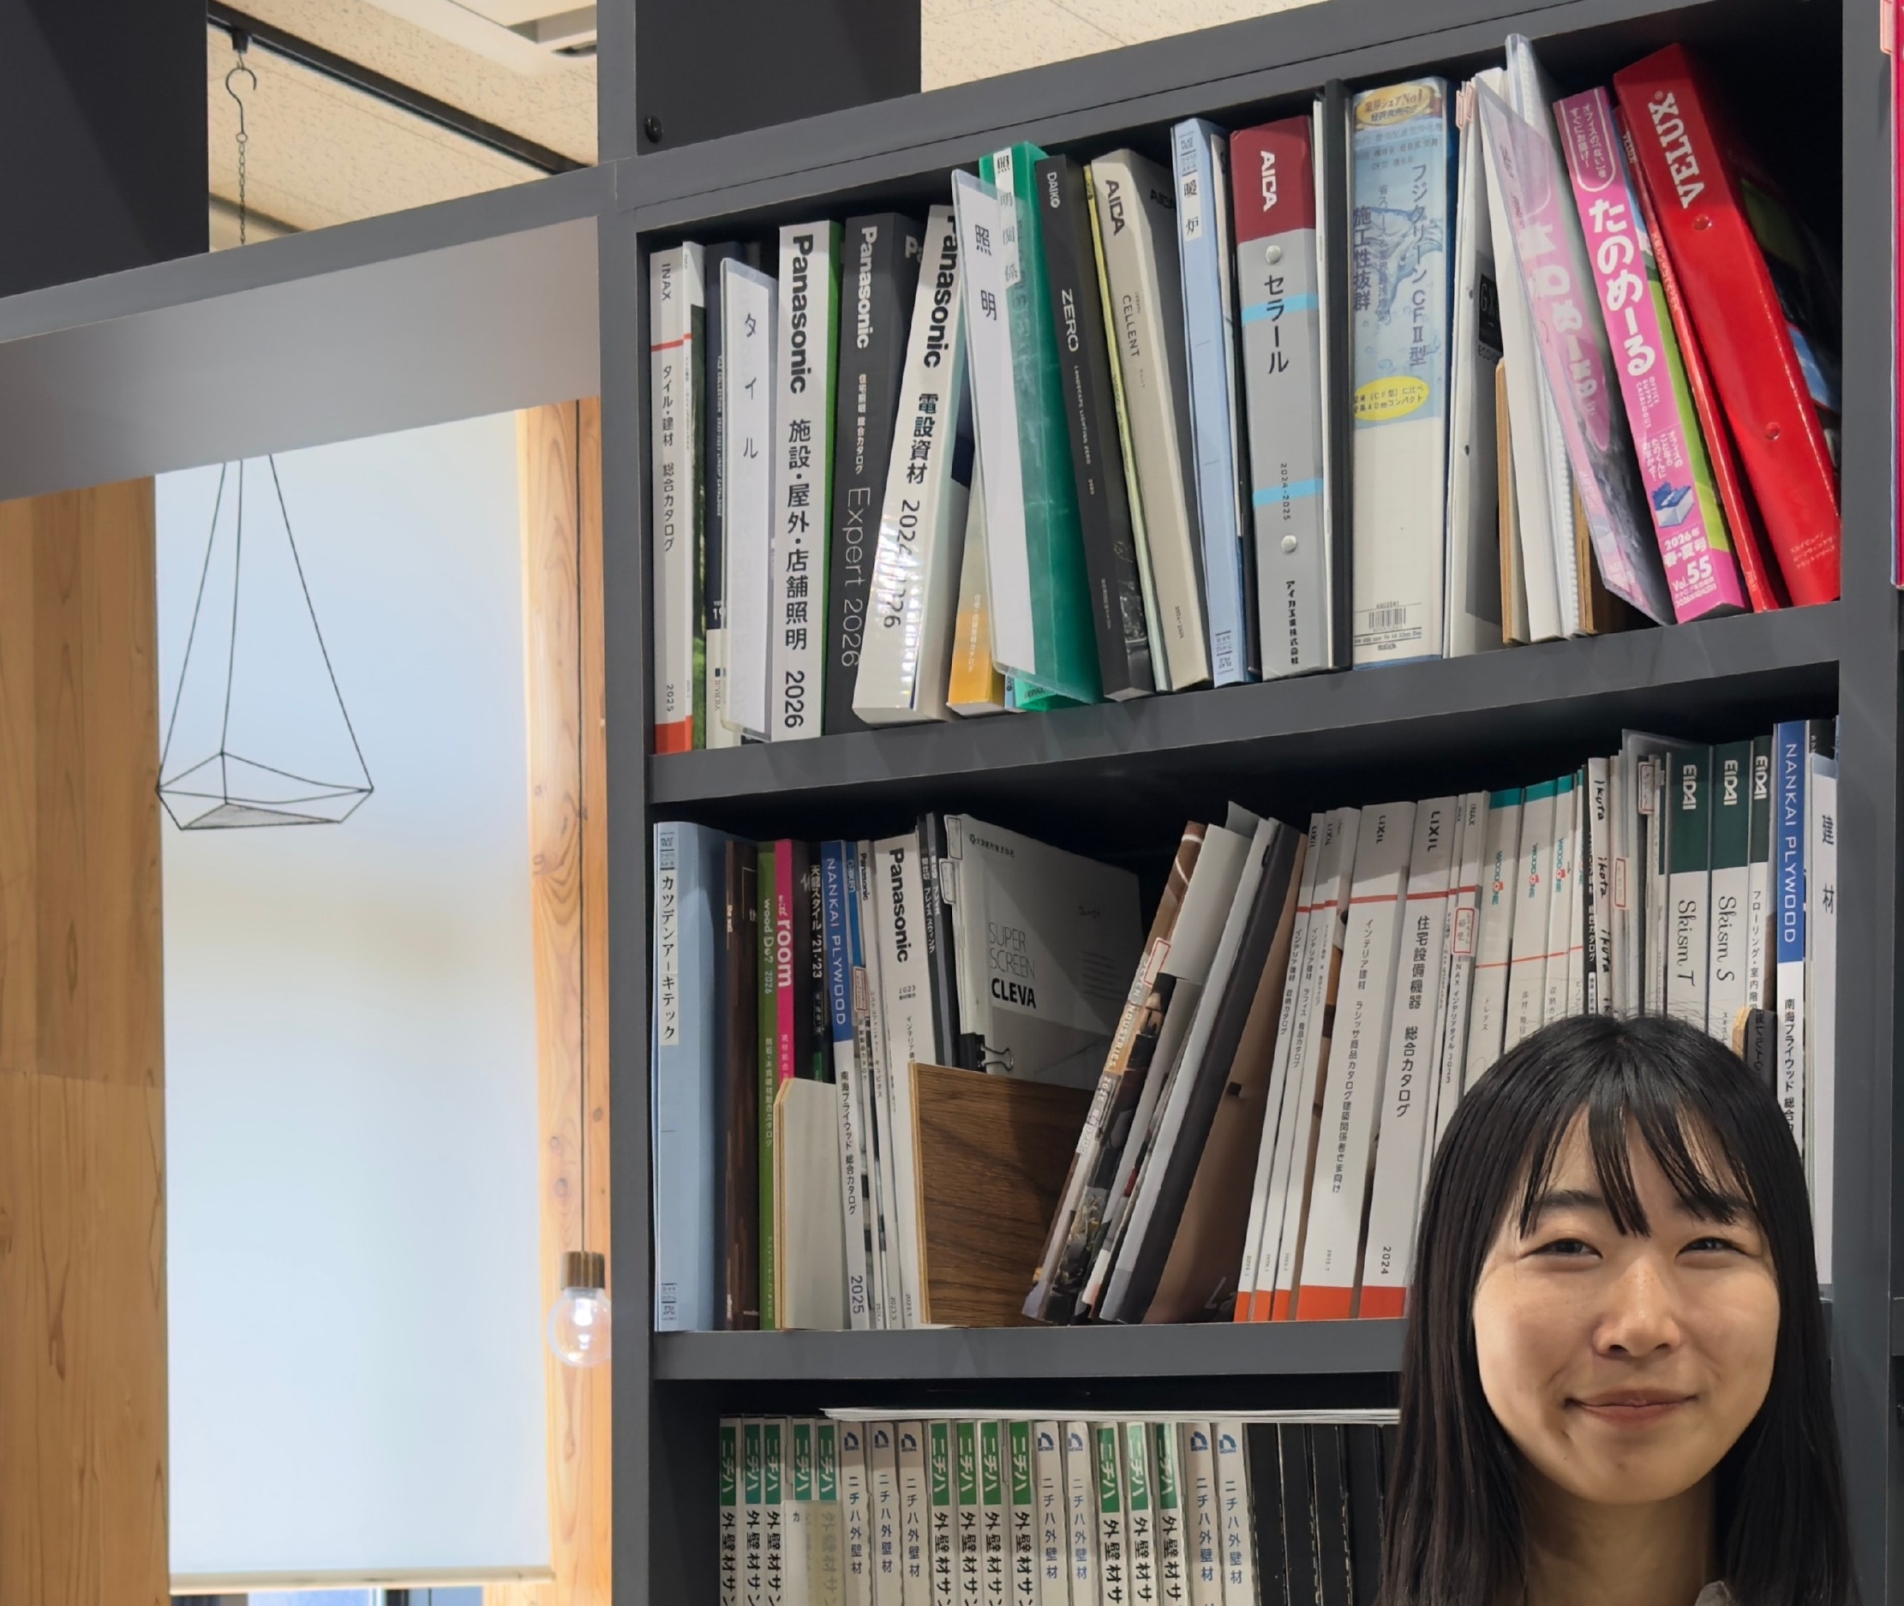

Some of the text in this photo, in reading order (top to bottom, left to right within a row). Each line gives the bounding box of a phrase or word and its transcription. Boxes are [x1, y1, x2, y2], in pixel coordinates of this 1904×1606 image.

[1260, 151, 1278, 212] AICA
[1648, 91, 1705, 209] VELUX
[997, 155, 1021, 283] 照明関係
[1047, 171, 1061, 209] DAIKO
[1184, 181, 1200, 236] 暖炉
[661, 263, 671, 301] INAX
[975, 224, 997, 321] 照明
[1589, 199, 1656, 376] たのめーる
[1061, 289, 1079, 352] ZERO
[1122, 295, 1140, 357] CELLENT
[1264, 274, 1289, 375] セラール
[744, 314, 758, 458] タイル
[841, 226, 878, 667] Panasonic Expert 2026
[906, 393, 939, 484] 電設資材
[663, 463, 674, 552] 総合カタログ
[785, 234, 814, 729] Panasonic 施設・屋外・店舗照明 2026
[666, 684, 674, 712] 2025
[1784, 743, 1798, 827] NANKAI
[826, 858, 840, 927] NANKAI
[889, 848, 912, 963] Panasonic
[1784, 836, 1798, 943] PLYWOOD
[661, 876, 676, 1040] カツデンアーキテック
[777, 919, 792, 988] room
[988, 922, 1027, 953] SUPER
[990, 948, 1036, 981] SCREEN
[1357, 918, 1374, 990] インテリア建材
[1677, 899, 1697, 967] Skism
[1717, 895, 1738, 963] Skism
[831, 936, 846, 1025] PLYWOOD
[991, 977, 1037, 1009] CLEVA
[1381, 810, 1440, 1275] LIXIL 住宅設備機器 総合カタログ 2024
[851, 1275, 865, 1314] 2025
[723, 1438, 735, 1492] ニチハ
[933, 1436, 947, 1493] ニチハ
[1013, 1436, 1029, 1492] ニチハ
[849, 1476, 863, 1575] ニチハ外壁材
[1225, 1480, 1243, 1585] ニチハ外壁材
